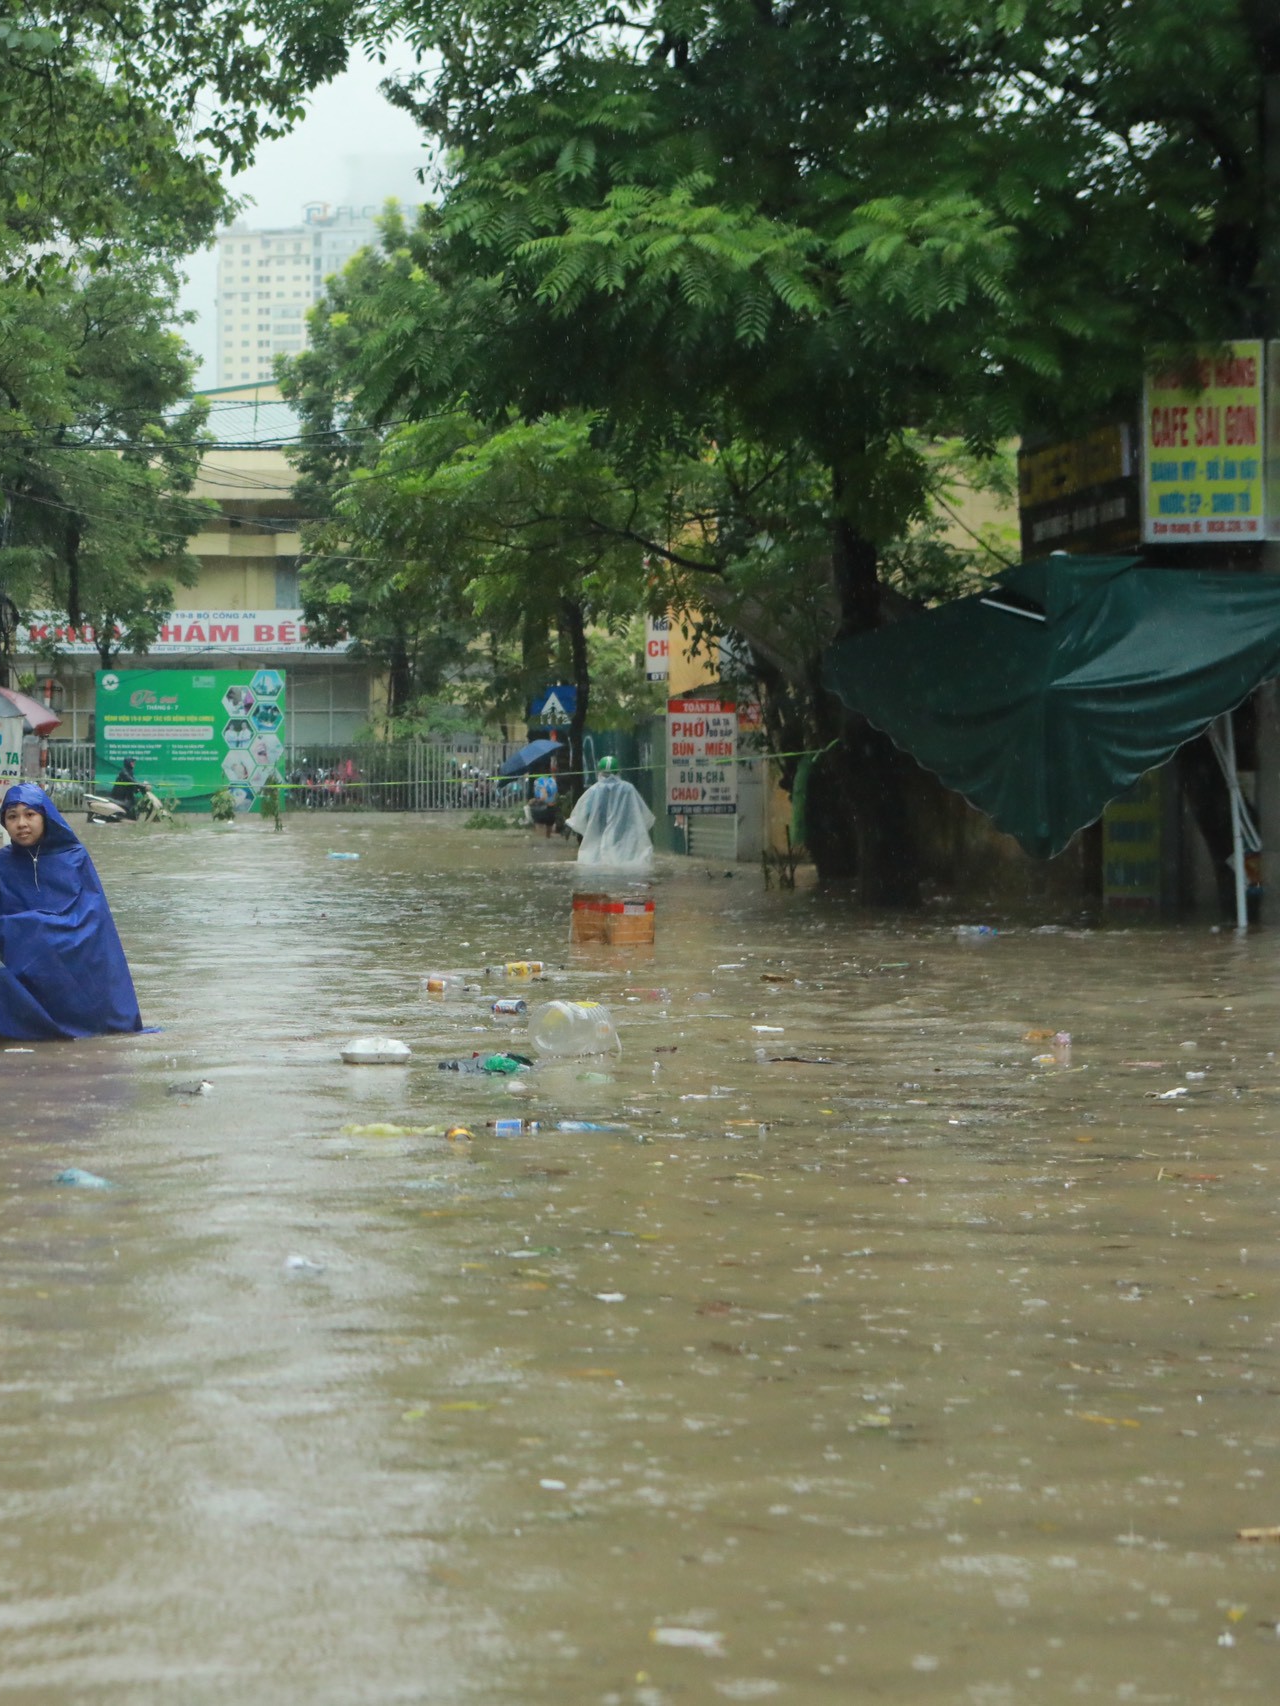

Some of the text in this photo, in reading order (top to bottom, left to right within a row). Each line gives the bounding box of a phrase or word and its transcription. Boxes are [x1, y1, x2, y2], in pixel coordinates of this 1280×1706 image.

[1152, 406, 1189, 447] CAFE
[196, 612, 209, 620] BỘ
[212, 611, 239, 619] CÔNG
[160, 621, 239, 642] HÁM
[683, 702, 706, 712] TOÀN
[671, 717, 704, 737] PHỞ
[672, 740, 694, 756] BÚN
[705, 738, 732, 756] MIẾN
[5, 752, 19, 765] TA
